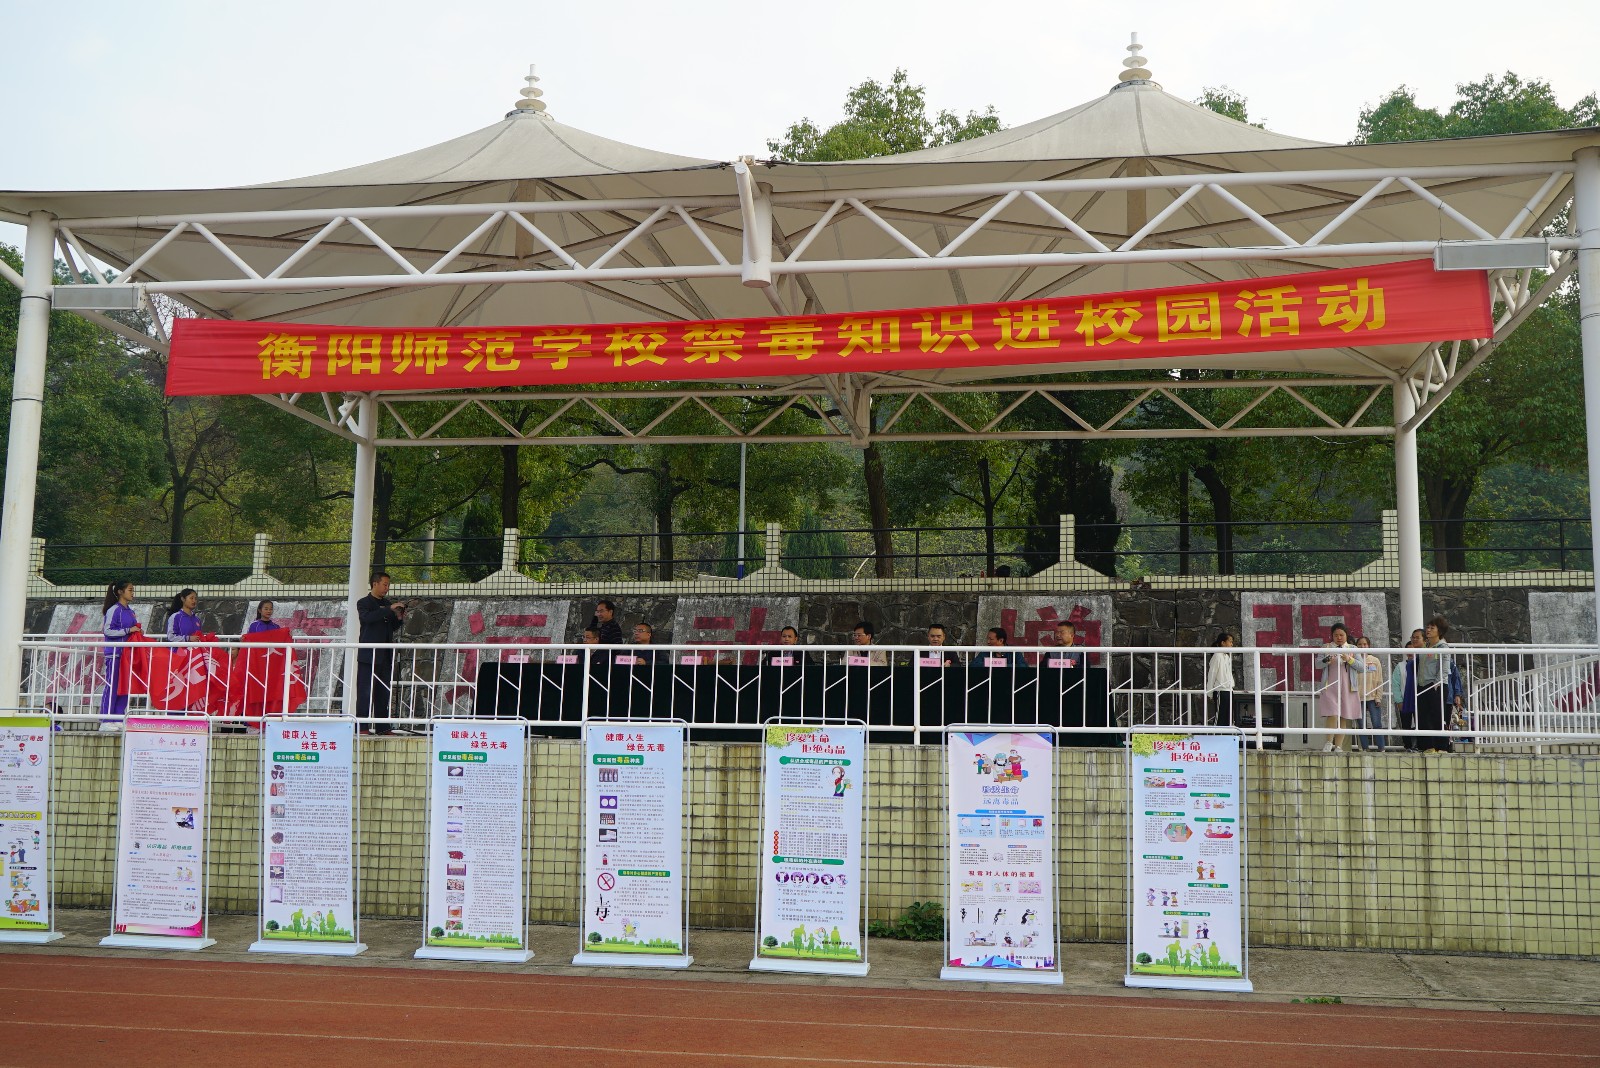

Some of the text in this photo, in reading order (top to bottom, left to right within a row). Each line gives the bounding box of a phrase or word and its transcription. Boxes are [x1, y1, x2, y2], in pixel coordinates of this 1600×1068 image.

[257, 278, 1387, 381] 衡阳师范学校禁毒知识进校园活动
[281, 730, 318, 740] 健康人生
[450, 730, 488, 740] 健康人生
[605, 732, 645, 742] 健康人生
[785, 732, 831, 744] 珍爱生命
[301, 741, 338, 751] 绿色无毒
[470, 740, 508, 750] 绿色无毒
[626, 742, 666, 752] 绿色无毒
[801, 743, 846, 755] 拒绝毒品
[1152, 740, 1201, 752] 珍爱生命
[1170, 752, 1219, 763] 拒绝毒品
